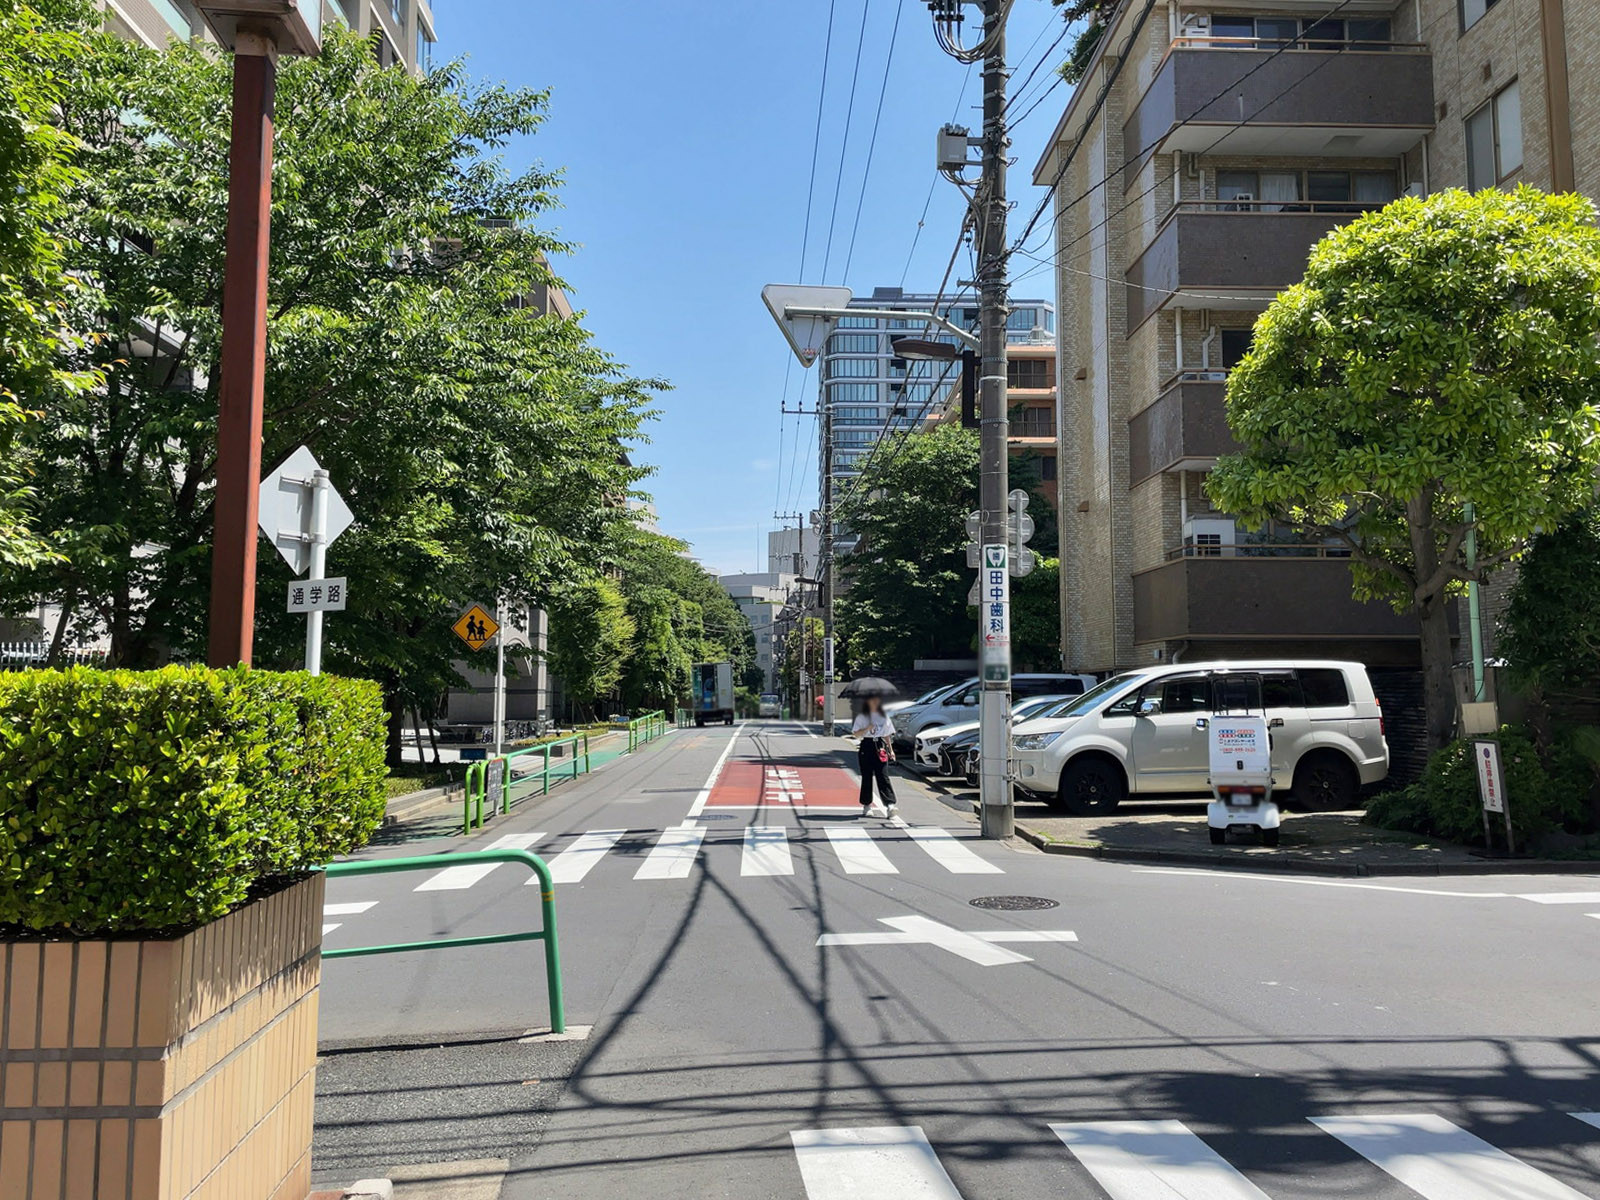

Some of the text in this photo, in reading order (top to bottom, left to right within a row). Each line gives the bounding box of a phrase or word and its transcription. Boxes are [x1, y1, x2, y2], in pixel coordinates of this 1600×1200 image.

[292, 585, 340, 605] 通学路
[990, 571, 1004, 633] 田中歯科
